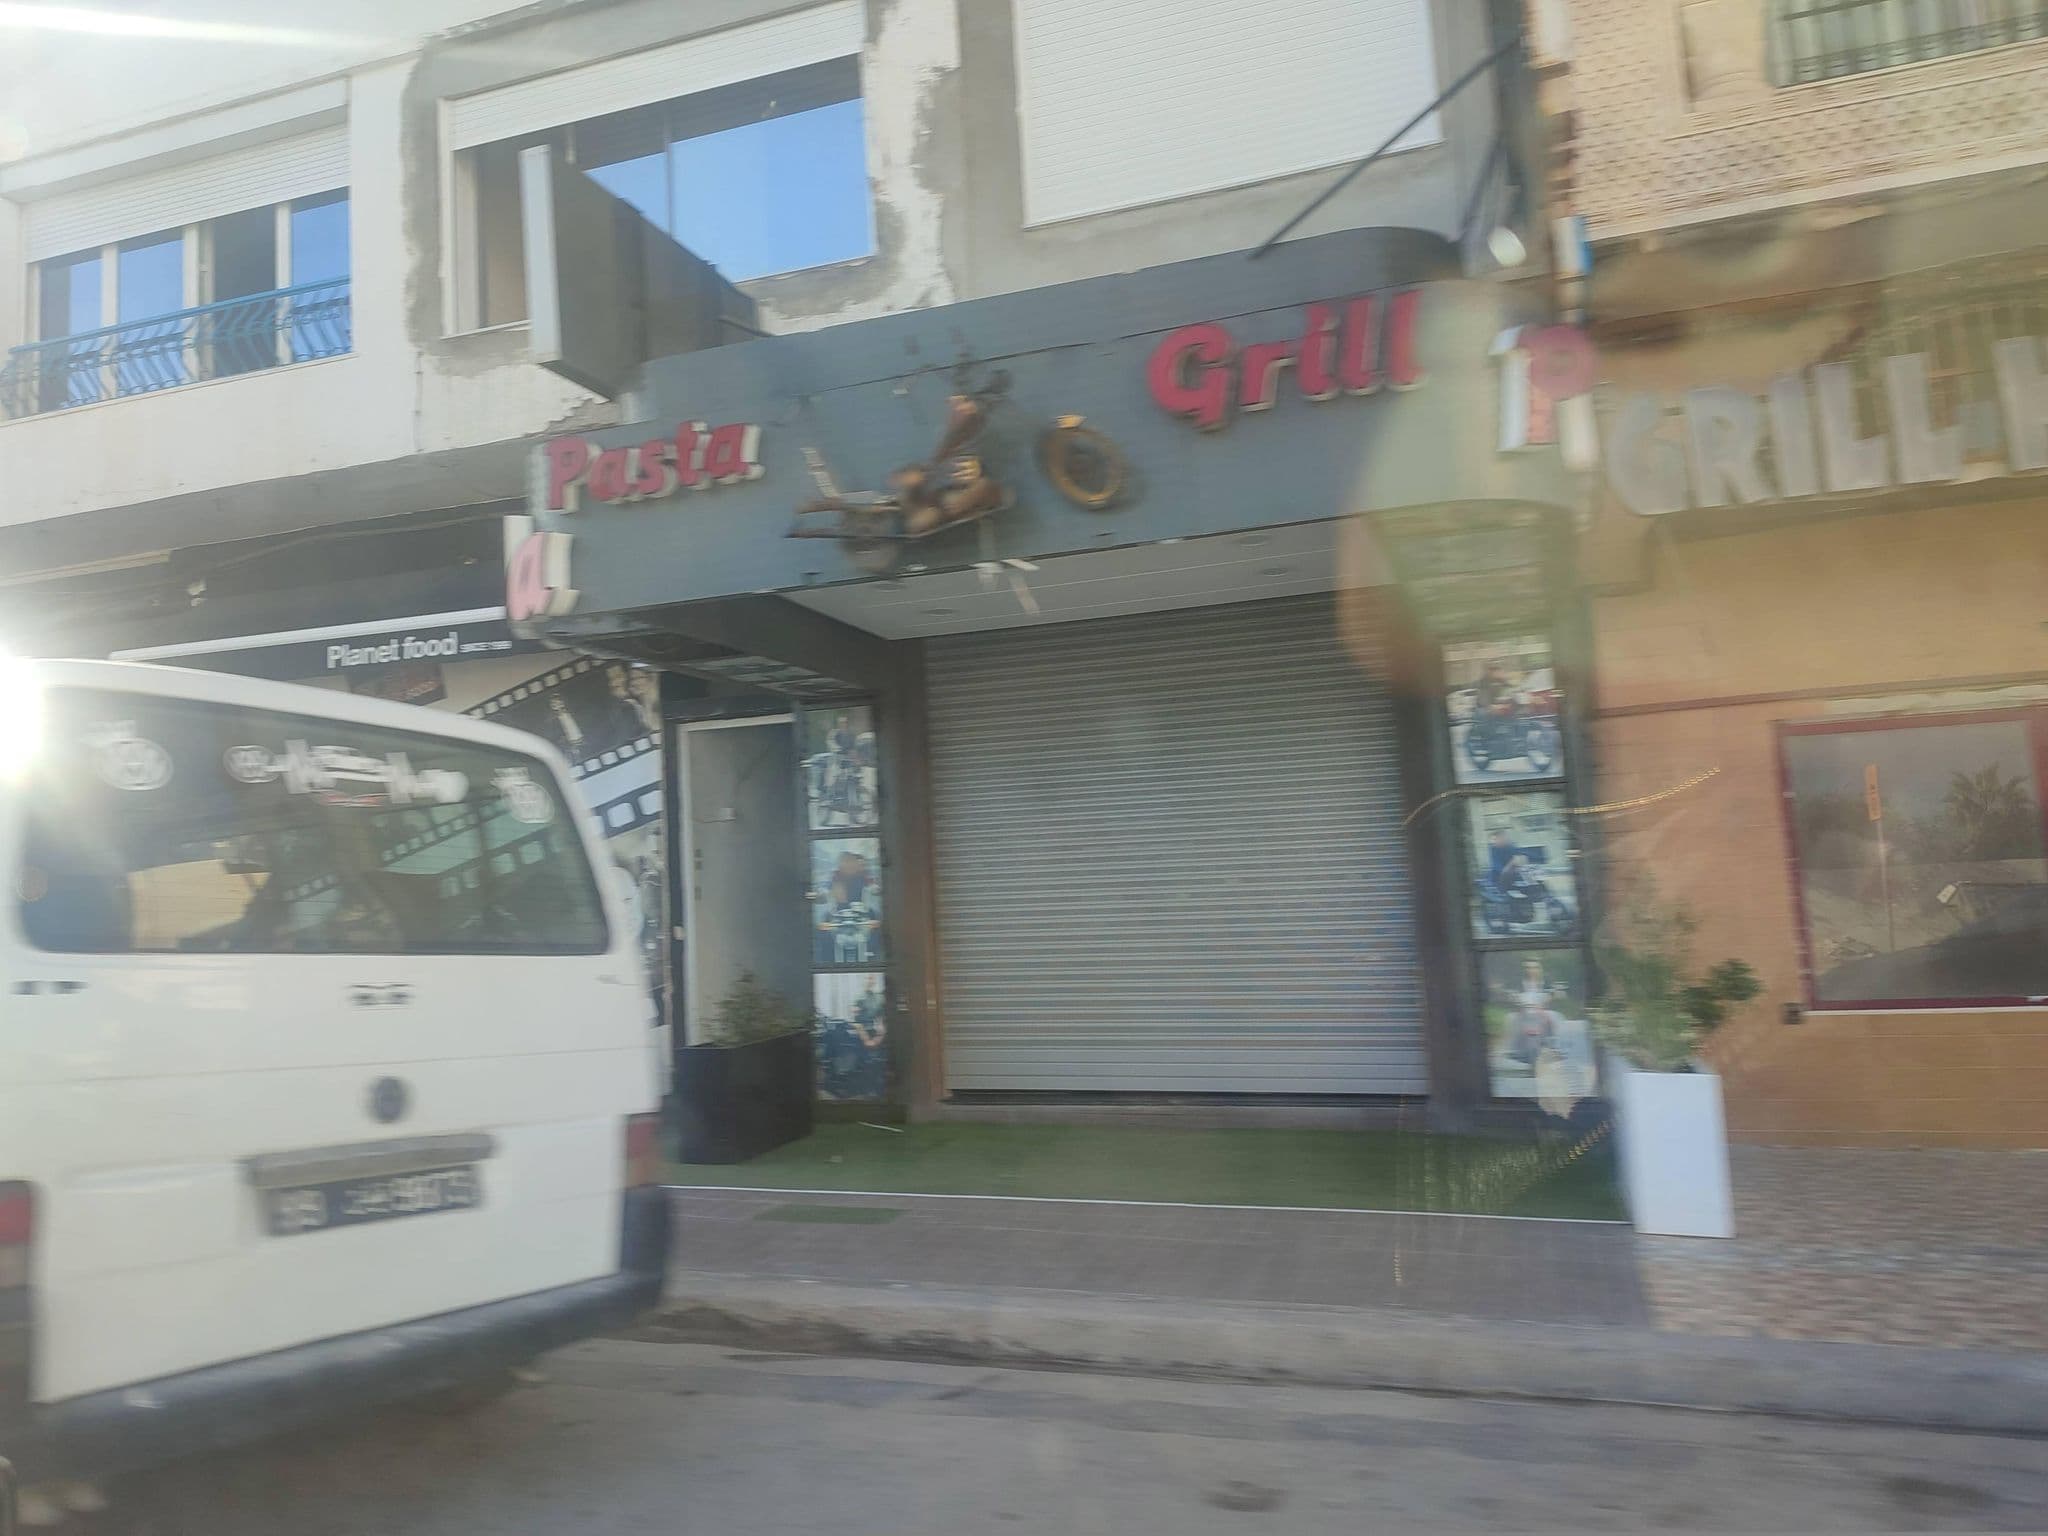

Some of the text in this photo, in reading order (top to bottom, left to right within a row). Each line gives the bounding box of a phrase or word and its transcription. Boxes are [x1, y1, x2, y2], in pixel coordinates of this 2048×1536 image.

[1146, 289, 1424, 432] Grill
[543, 420, 762, 512] Pasta
[1606, 351, 1962, 516] GRILL
[327, 638, 400, 669] Planet
[402, 632, 459, 660] food
